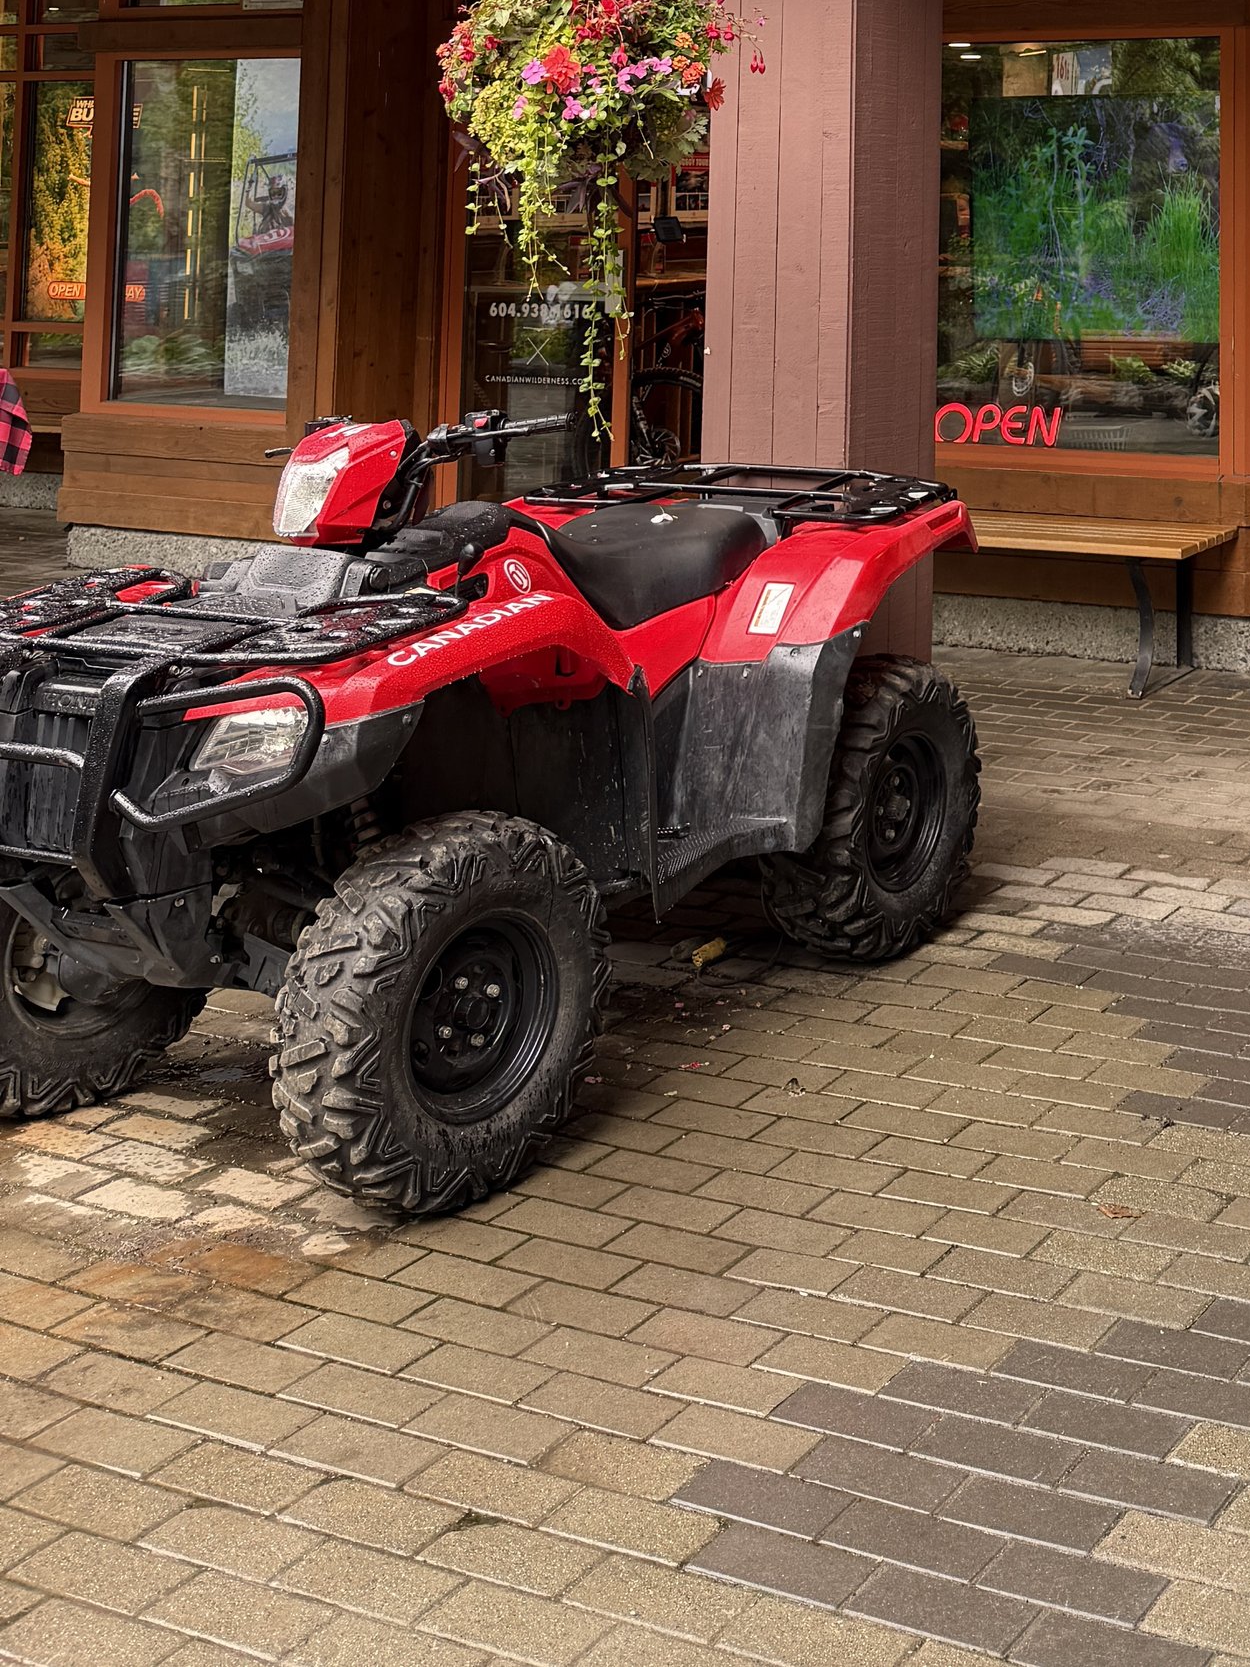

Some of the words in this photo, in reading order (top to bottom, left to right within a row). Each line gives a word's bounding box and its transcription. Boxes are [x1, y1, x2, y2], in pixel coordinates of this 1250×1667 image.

[51, 284, 81, 298] OPEN
[485, 374, 586, 385] CANADIANWILDERNESS.CO
[934, 402, 1065, 447] OPEN
[387, 594, 554, 666] CANADIAN
